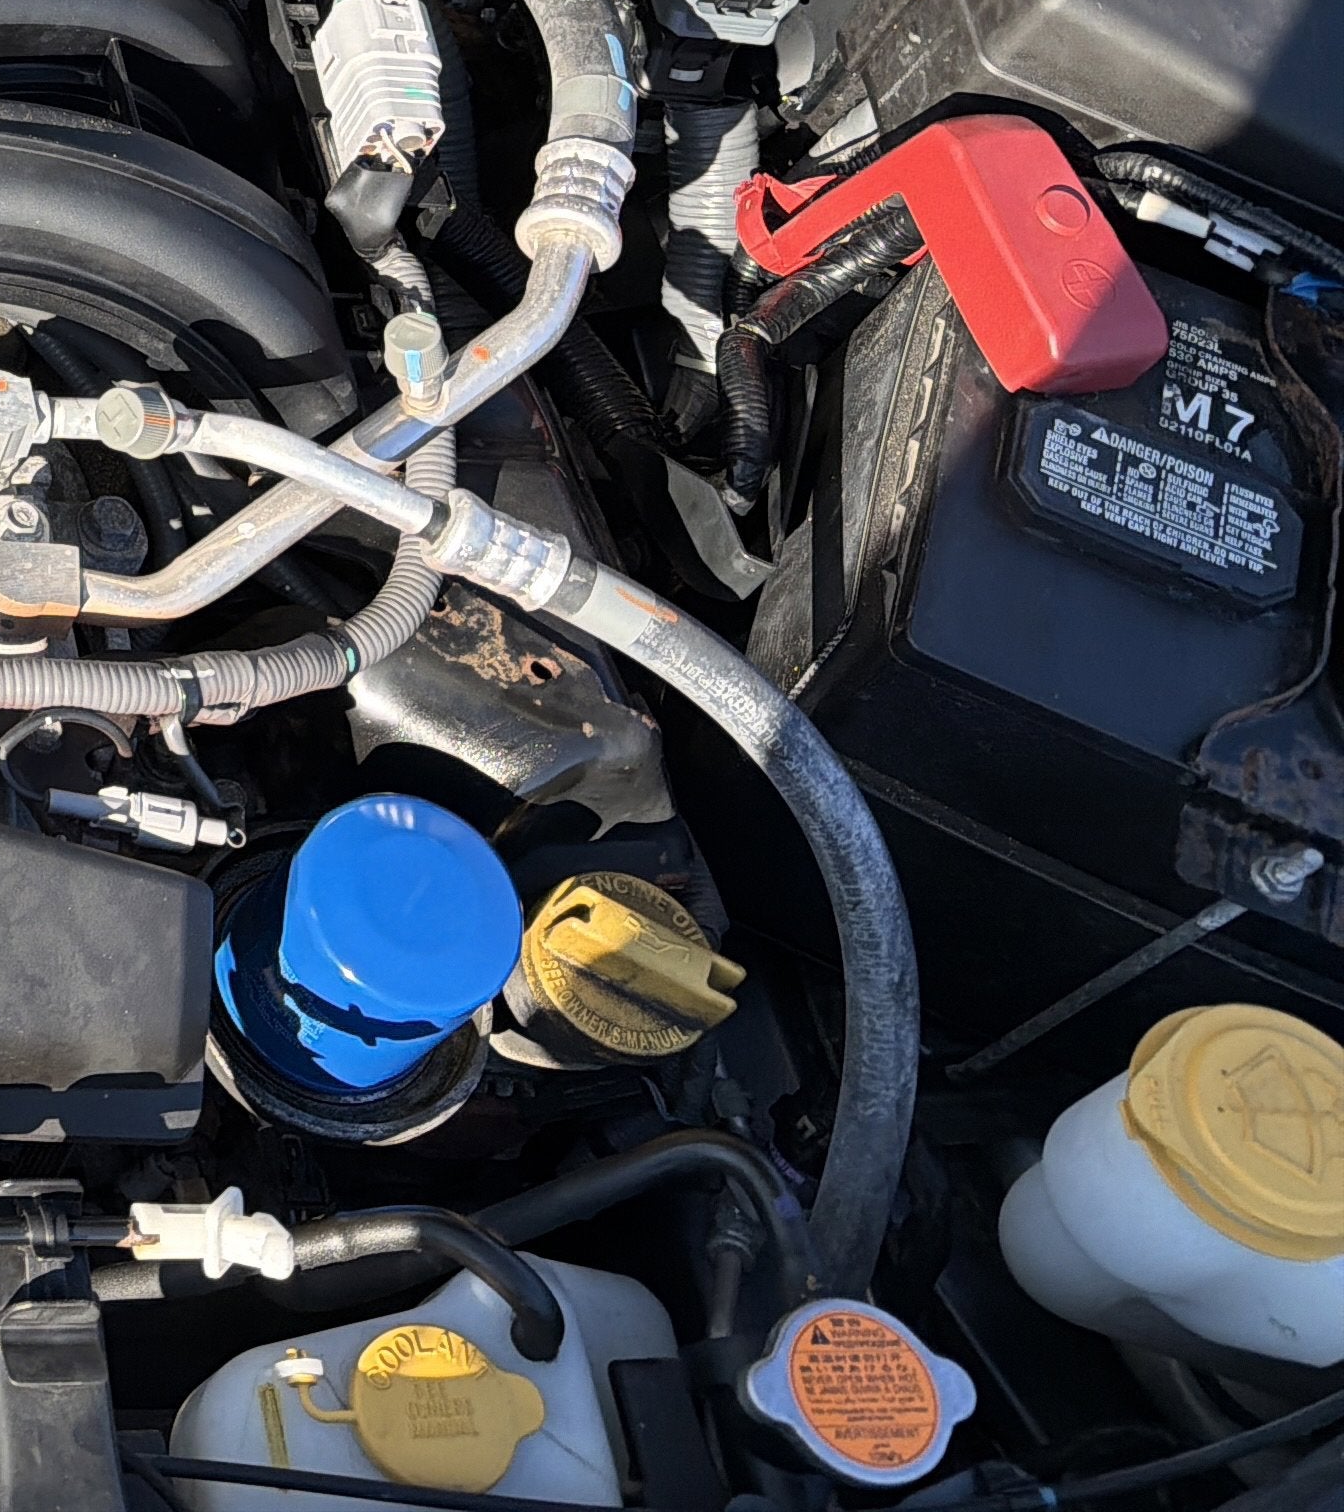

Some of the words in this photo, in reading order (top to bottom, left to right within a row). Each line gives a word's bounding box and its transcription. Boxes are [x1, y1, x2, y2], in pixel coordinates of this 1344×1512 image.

[1169, 340, 1196, 355] COLD
[1198, 350, 1249, 375] CRANKING
[1250, 371, 1277, 387] AMPS
[1197, 359, 1238, 381] AMPS
[1205, 374, 1228, 388] SIZE
[1222, 389, 1238, 403] 35
[1044, 439, 1088, 465] EXPLOSIVE
[1046, 429, 1076, 449] SHIELD
[1077, 442, 1098, 459] EYES
[1110, 432, 1214, 486] DANGER/POISON
[1043, 449, 1069, 468] GASES
[1070, 461, 1084, 473] CAN
[1085, 468, 1108, 483] CAUSE
[1127, 466, 1139, 478] NO
[1165, 482, 1186, 498] ACID
[1187, 493, 1203, 504] CAN
[1048, 477, 1070, 492] KEEP
[1072, 487, 1089, 500] OUT
[1091, 495, 1102, 505] OF
[1104, 501, 1120, 514] THE
[1122, 509, 1150, 528] REACH
[1153, 521, 1164, 530] OF
[1214, 546, 1227, 558] DO
[1228, 552, 1246, 566] NOT
[1081, 500, 1103, 515] KEEP
[1104, 510, 1127, 526] VENT
[1127, 519, 1151, 538] CAPS
[1153, 530, 1178, 548] TIGHT
[1179, 542, 1198, 555] AND
[581, 875, 670, 912] ENGINE
[541, 958, 567, 990] SEE
[558, 989, 622, 1046] OWNER'S
[622, 1025, 689, 1051] MANUAL
